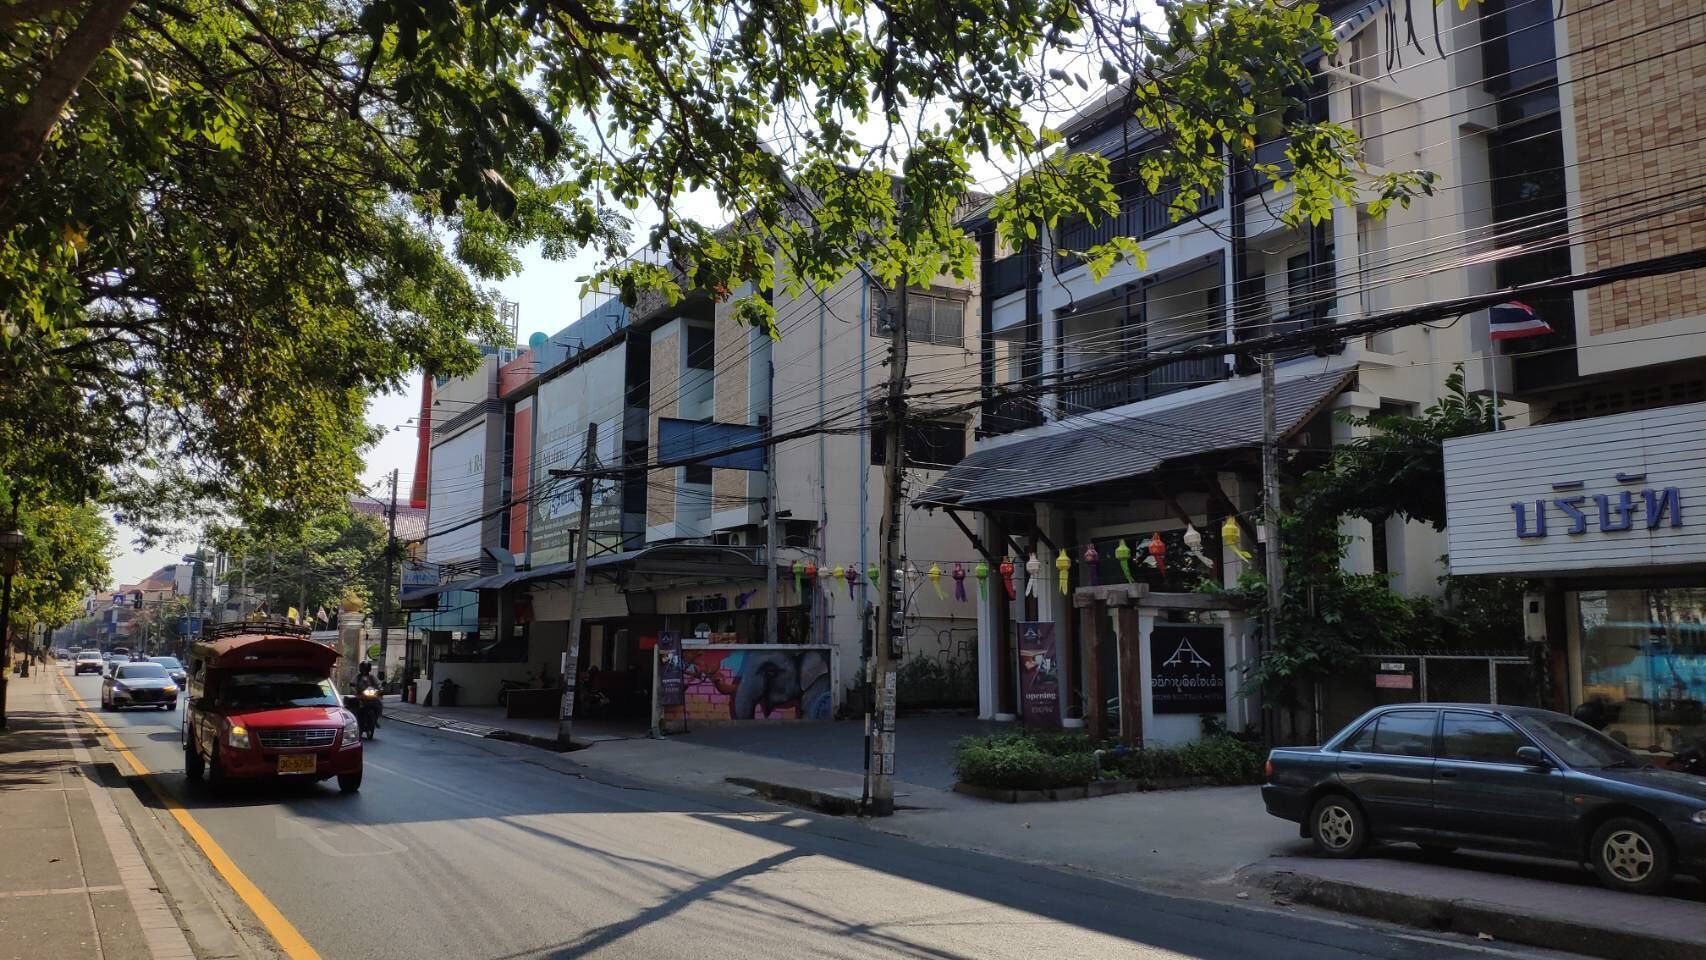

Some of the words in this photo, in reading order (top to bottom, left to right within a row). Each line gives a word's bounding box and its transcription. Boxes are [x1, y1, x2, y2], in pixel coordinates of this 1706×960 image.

[1511, 472, 1683, 539] บริษัท
[1025, 691, 1057, 701] opening
[1031, 705, 1055, 713] now
